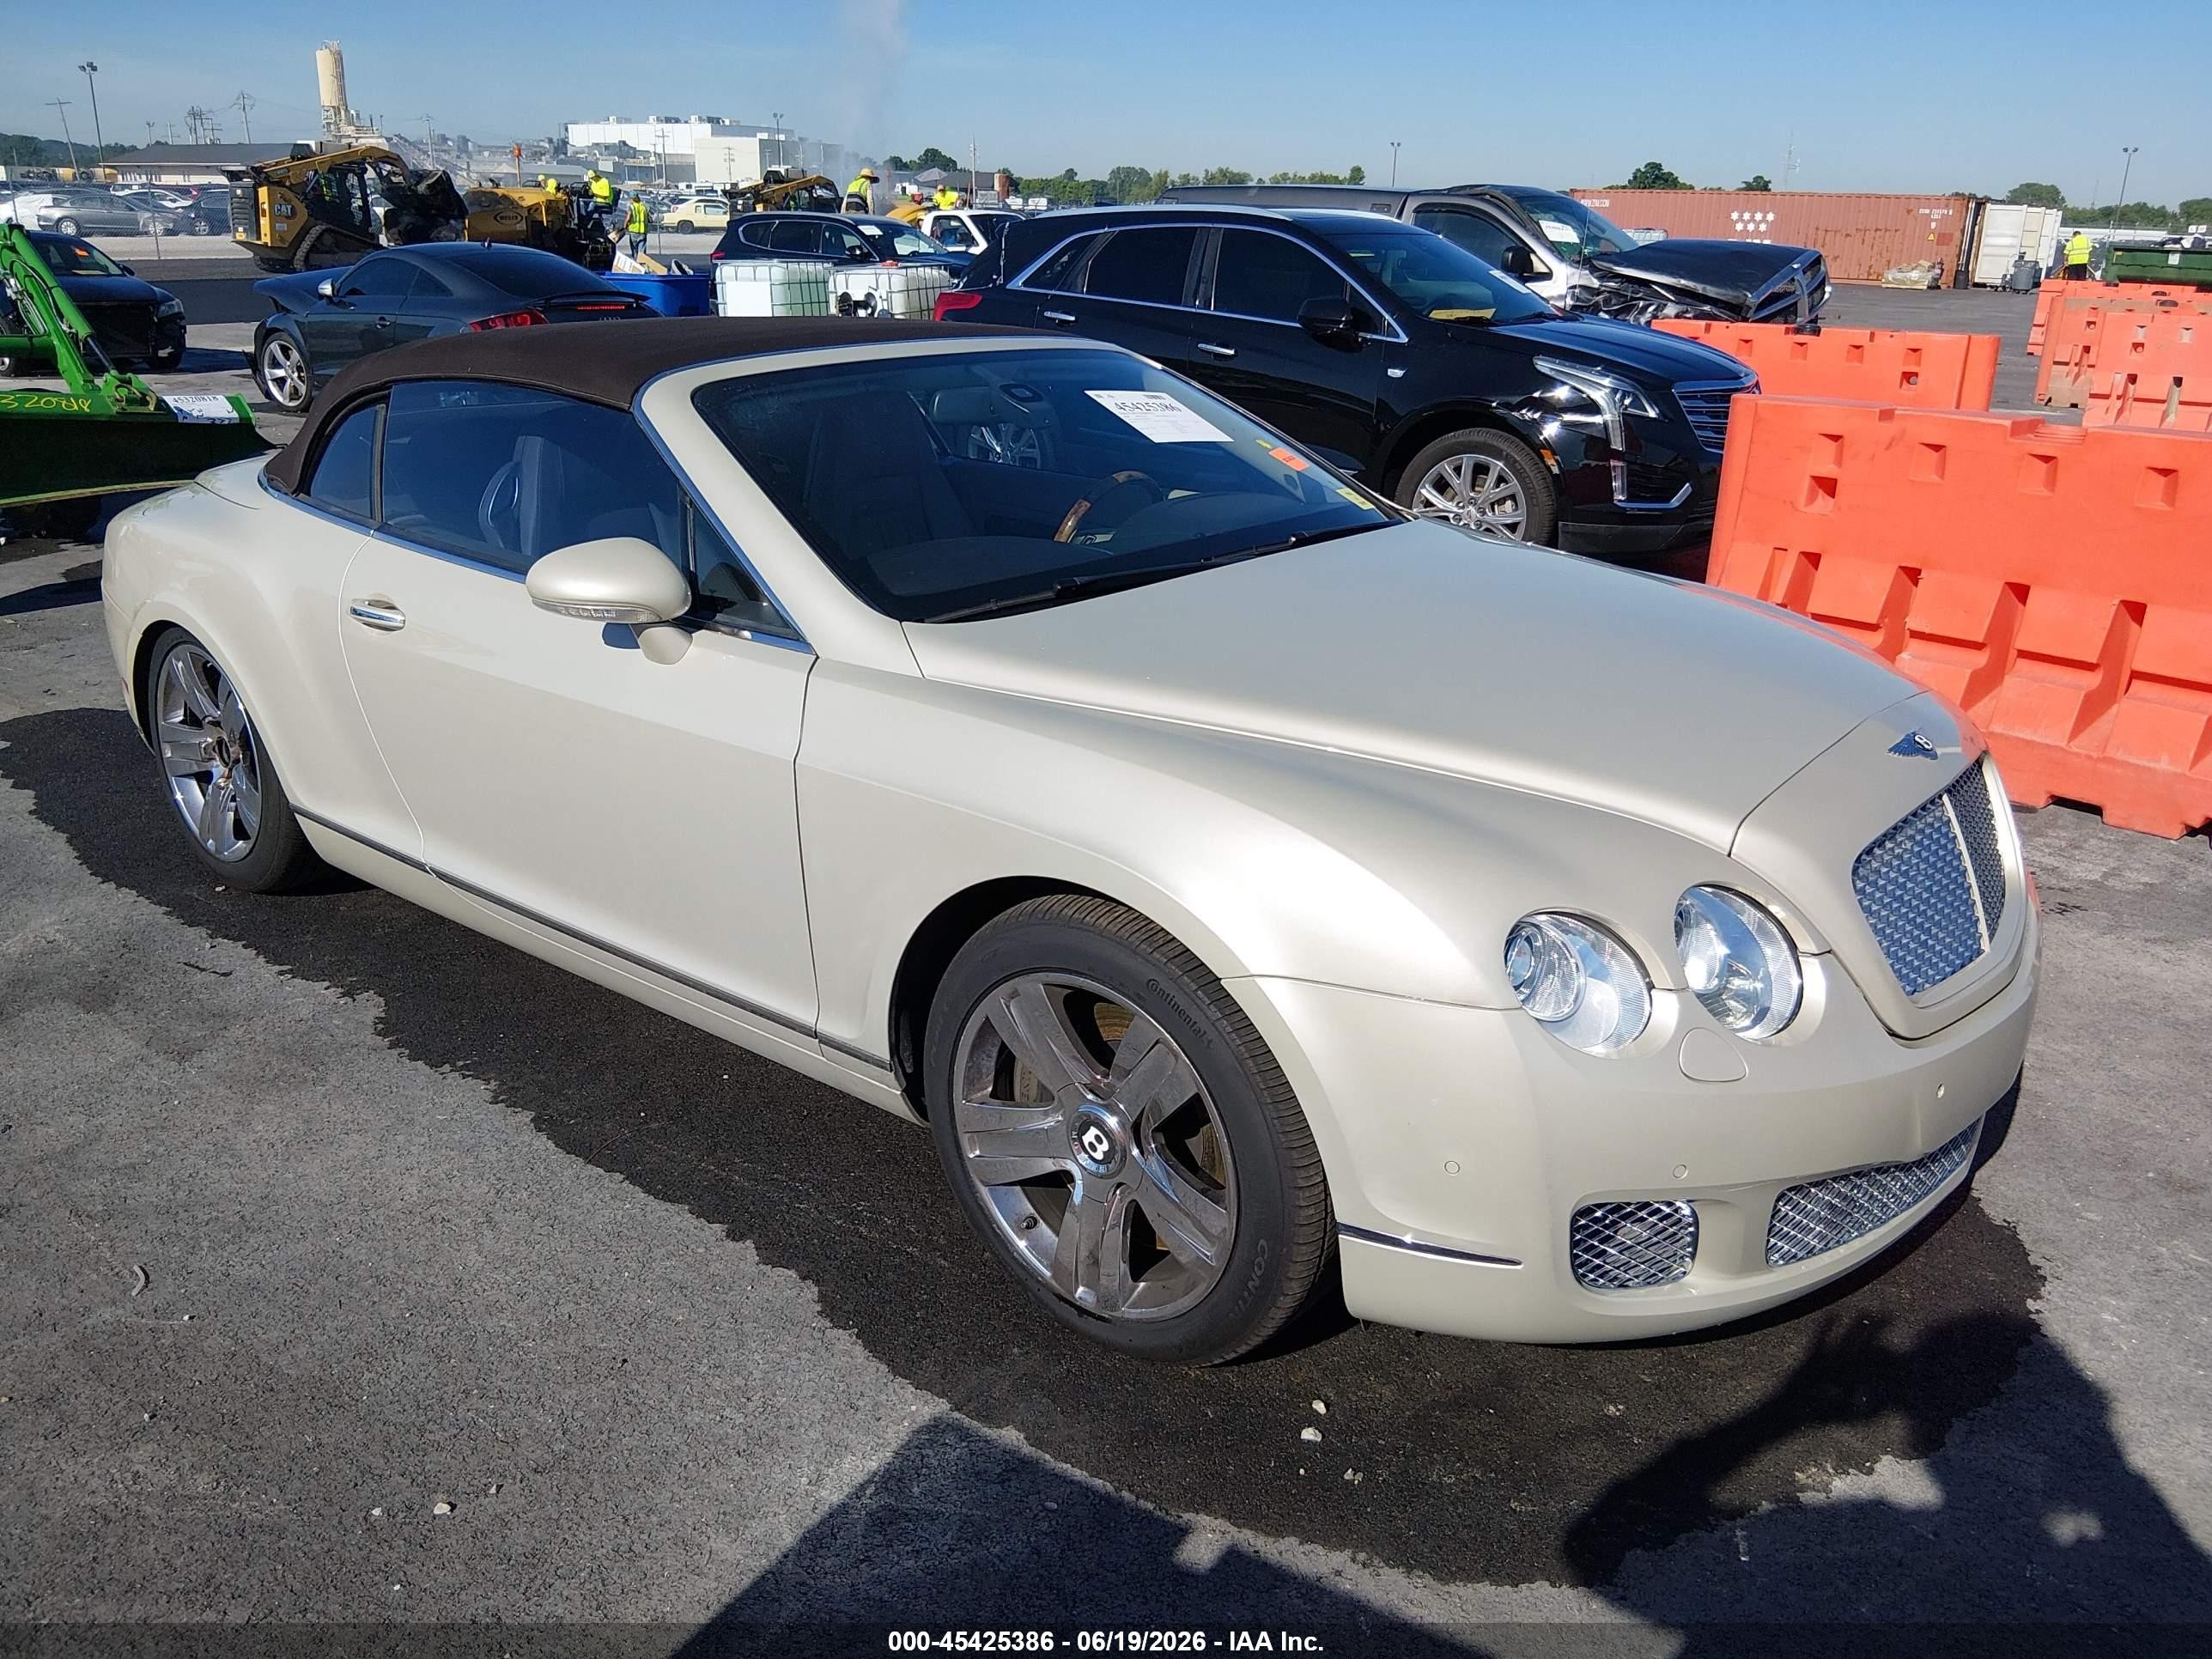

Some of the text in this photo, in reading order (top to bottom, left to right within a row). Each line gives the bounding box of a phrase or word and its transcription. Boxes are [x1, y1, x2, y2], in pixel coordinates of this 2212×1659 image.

[275, 204, 292, 216] CAT
[1114, 401, 1182, 413] 45425386
[1146, 978, 1207, 1038] Continental
